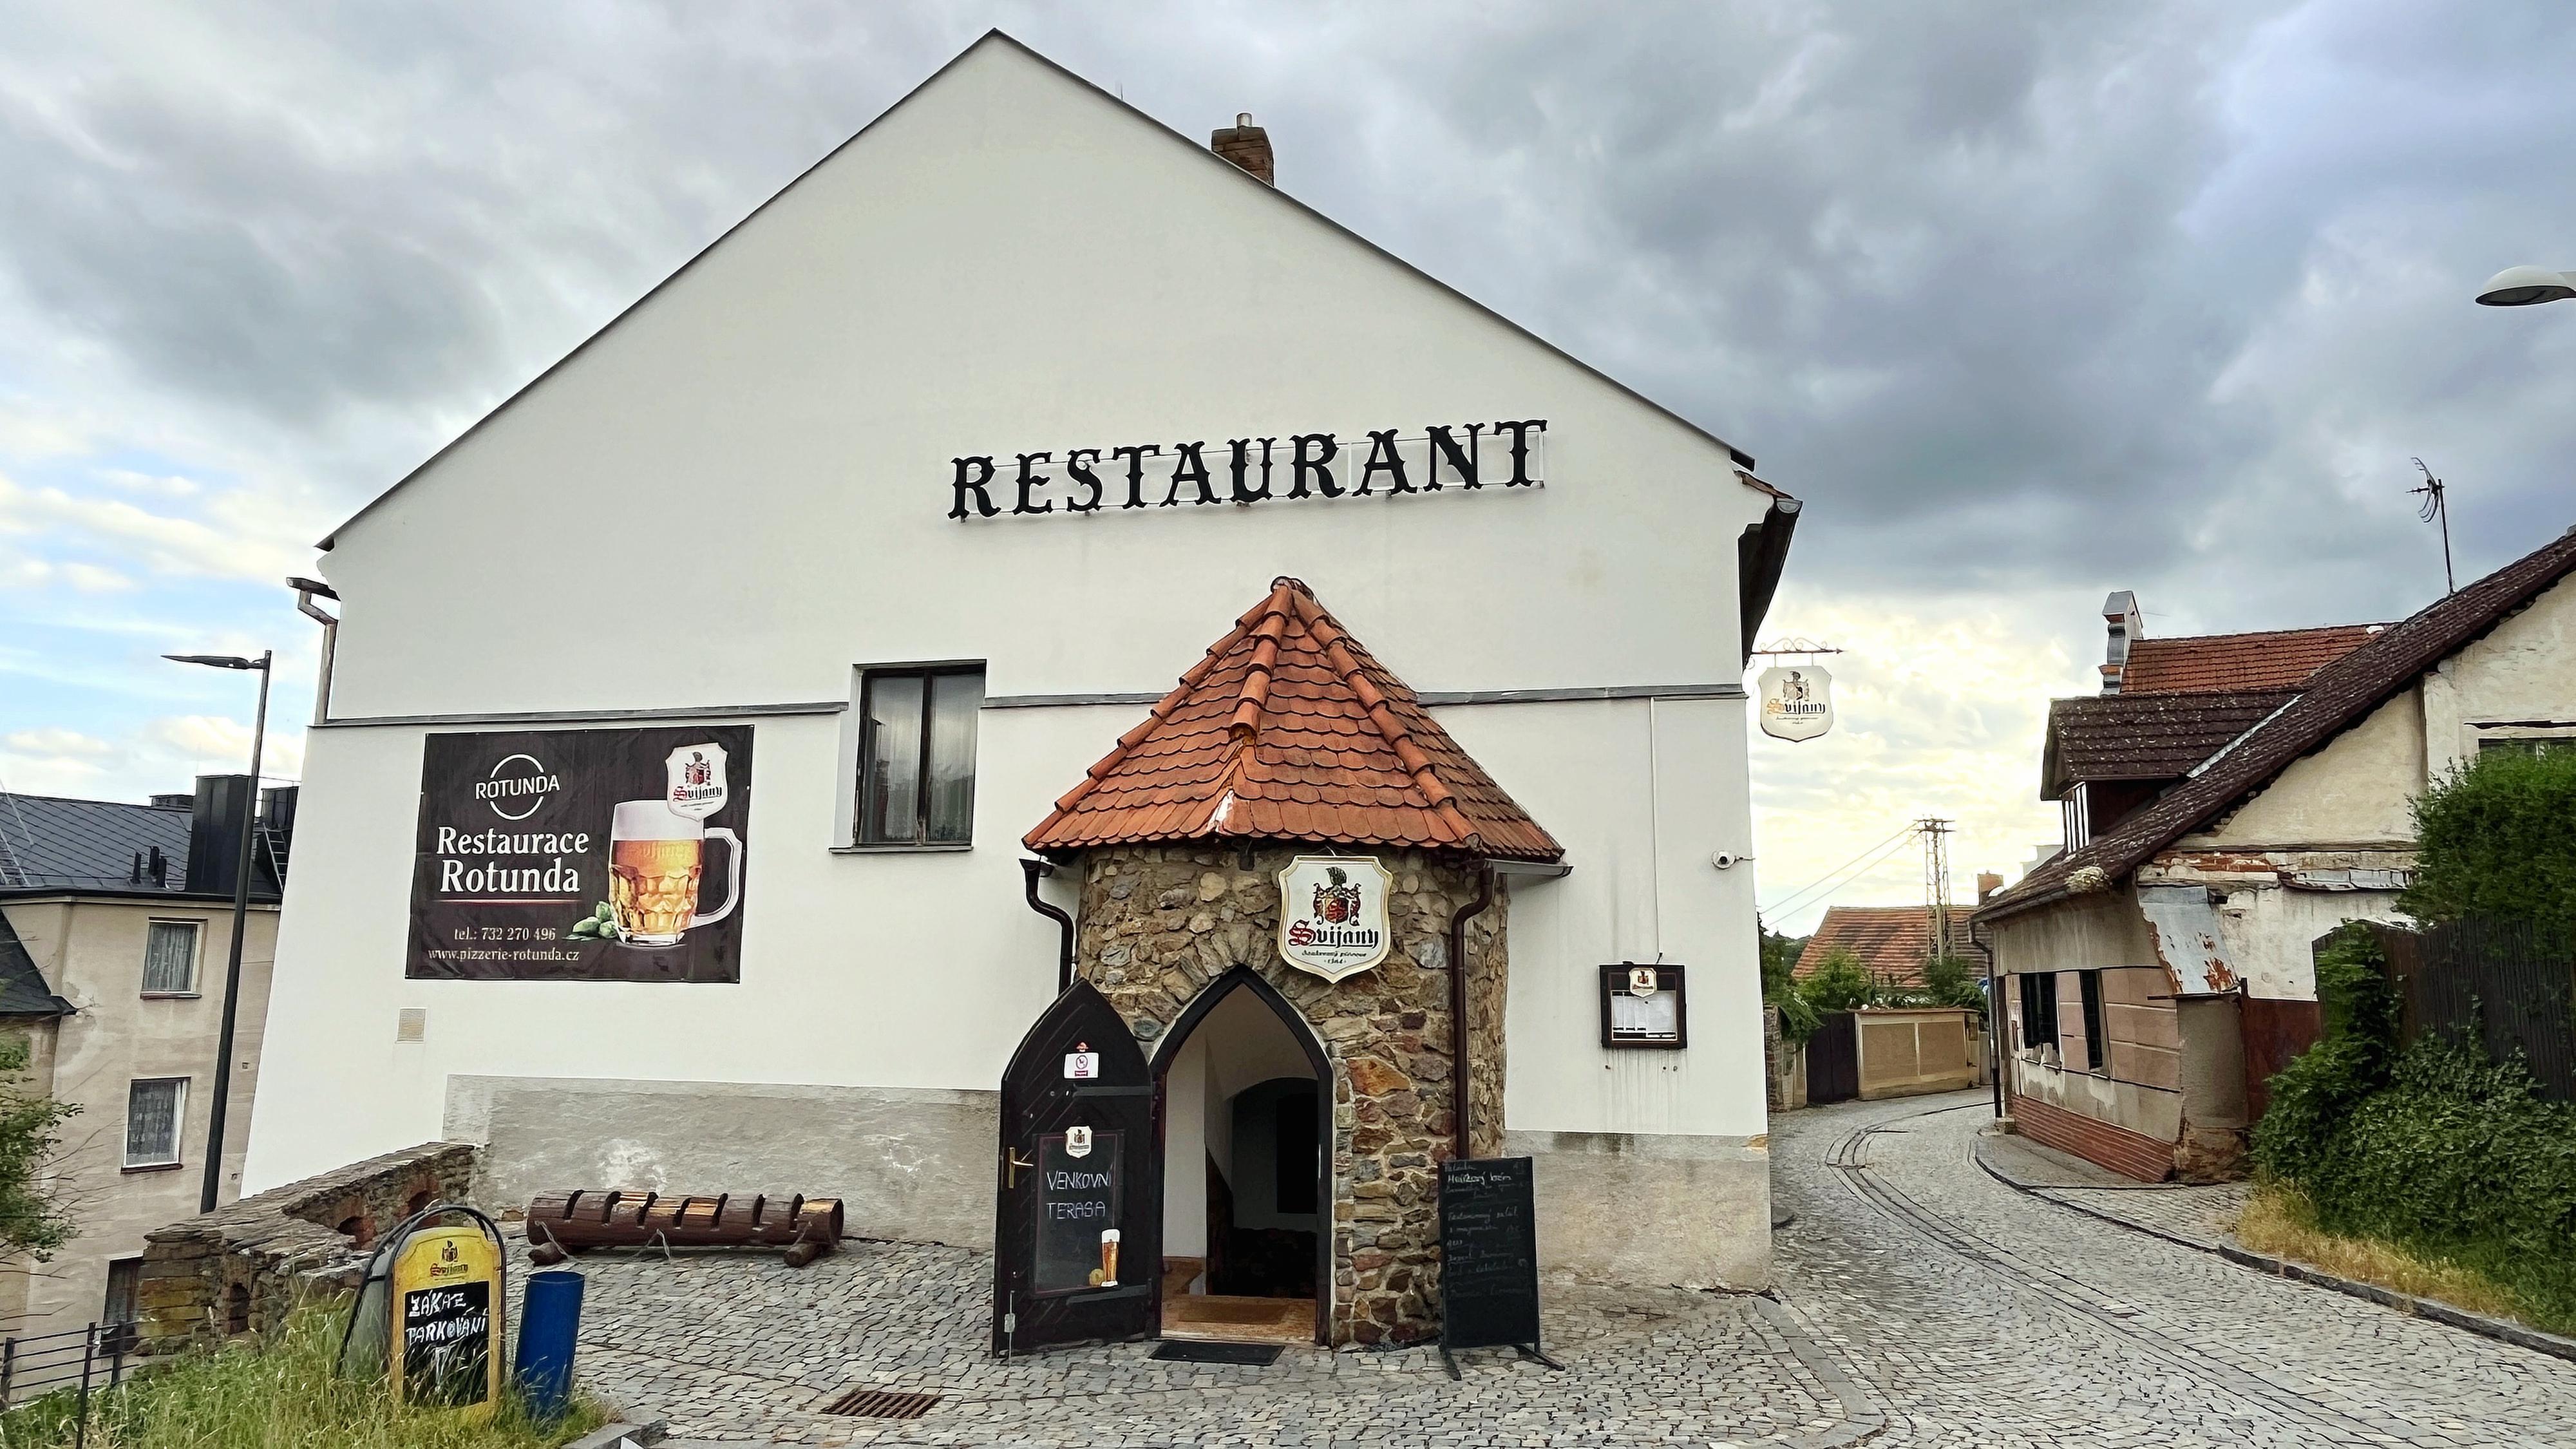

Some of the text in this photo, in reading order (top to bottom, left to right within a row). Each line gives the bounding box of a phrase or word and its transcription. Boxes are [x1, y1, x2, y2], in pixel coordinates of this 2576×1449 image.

[947, 419, 1548, 520] RESTAURANT
[475, 775, 560, 800] ROTUNDA
[673, 786, 722, 802] Svijany
[436, 827, 589, 855] Restaurace
[439, 857, 580, 893] Rotunda
[454, 927, 556, 940] tel.: 732 270 496
[1289, 920, 1379, 949] Svijany
[428, 947, 580, 961] www.pizzerie-rotunda.cz
[1046, 1201, 1106, 1219] TERASA
